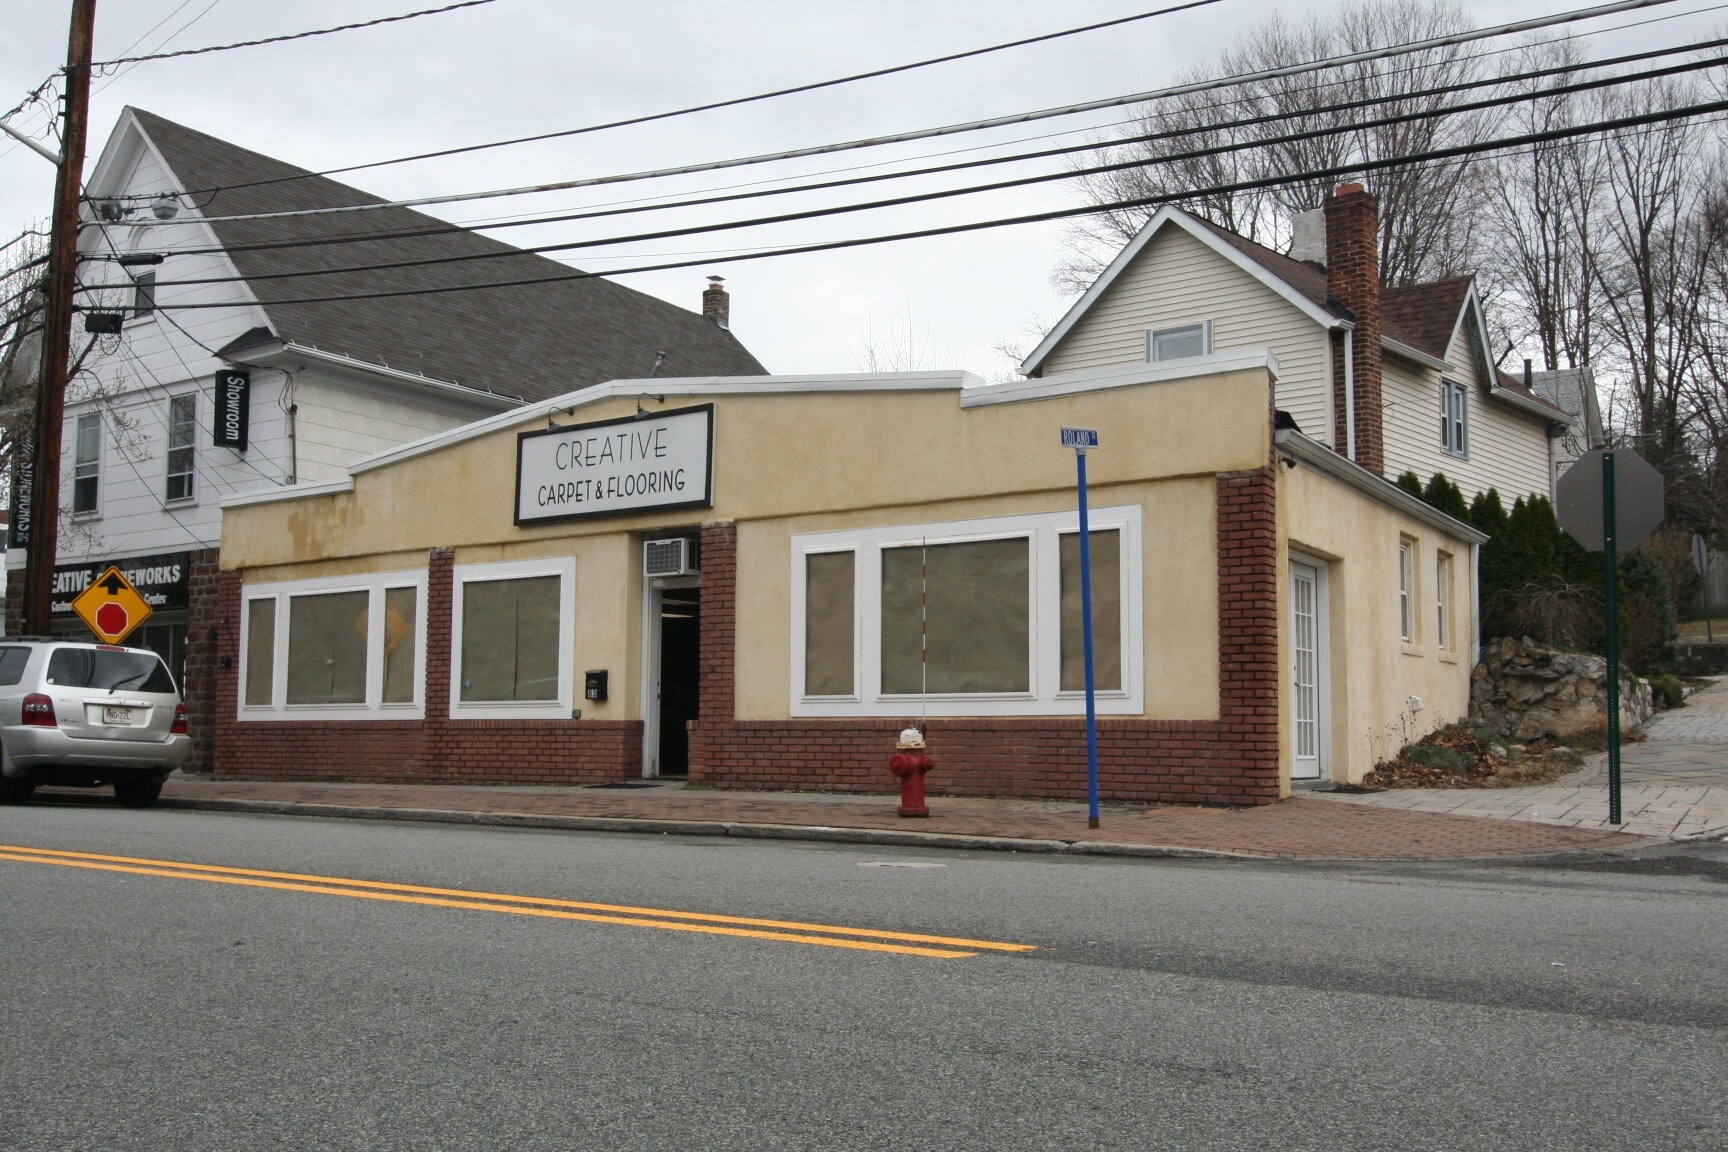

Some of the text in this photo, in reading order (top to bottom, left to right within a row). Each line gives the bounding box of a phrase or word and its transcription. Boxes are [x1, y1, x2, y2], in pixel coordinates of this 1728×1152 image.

[226, 376, 245, 440] Showroom
[555, 428, 668, 470] CREATIVE
[1063, 430, 1090, 445] ROLAND
[537, 468, 685, 506] CARPET & FLOORING
[51, 569, 92, 593] EATIVE
[143, 592, 167, 605] Center
